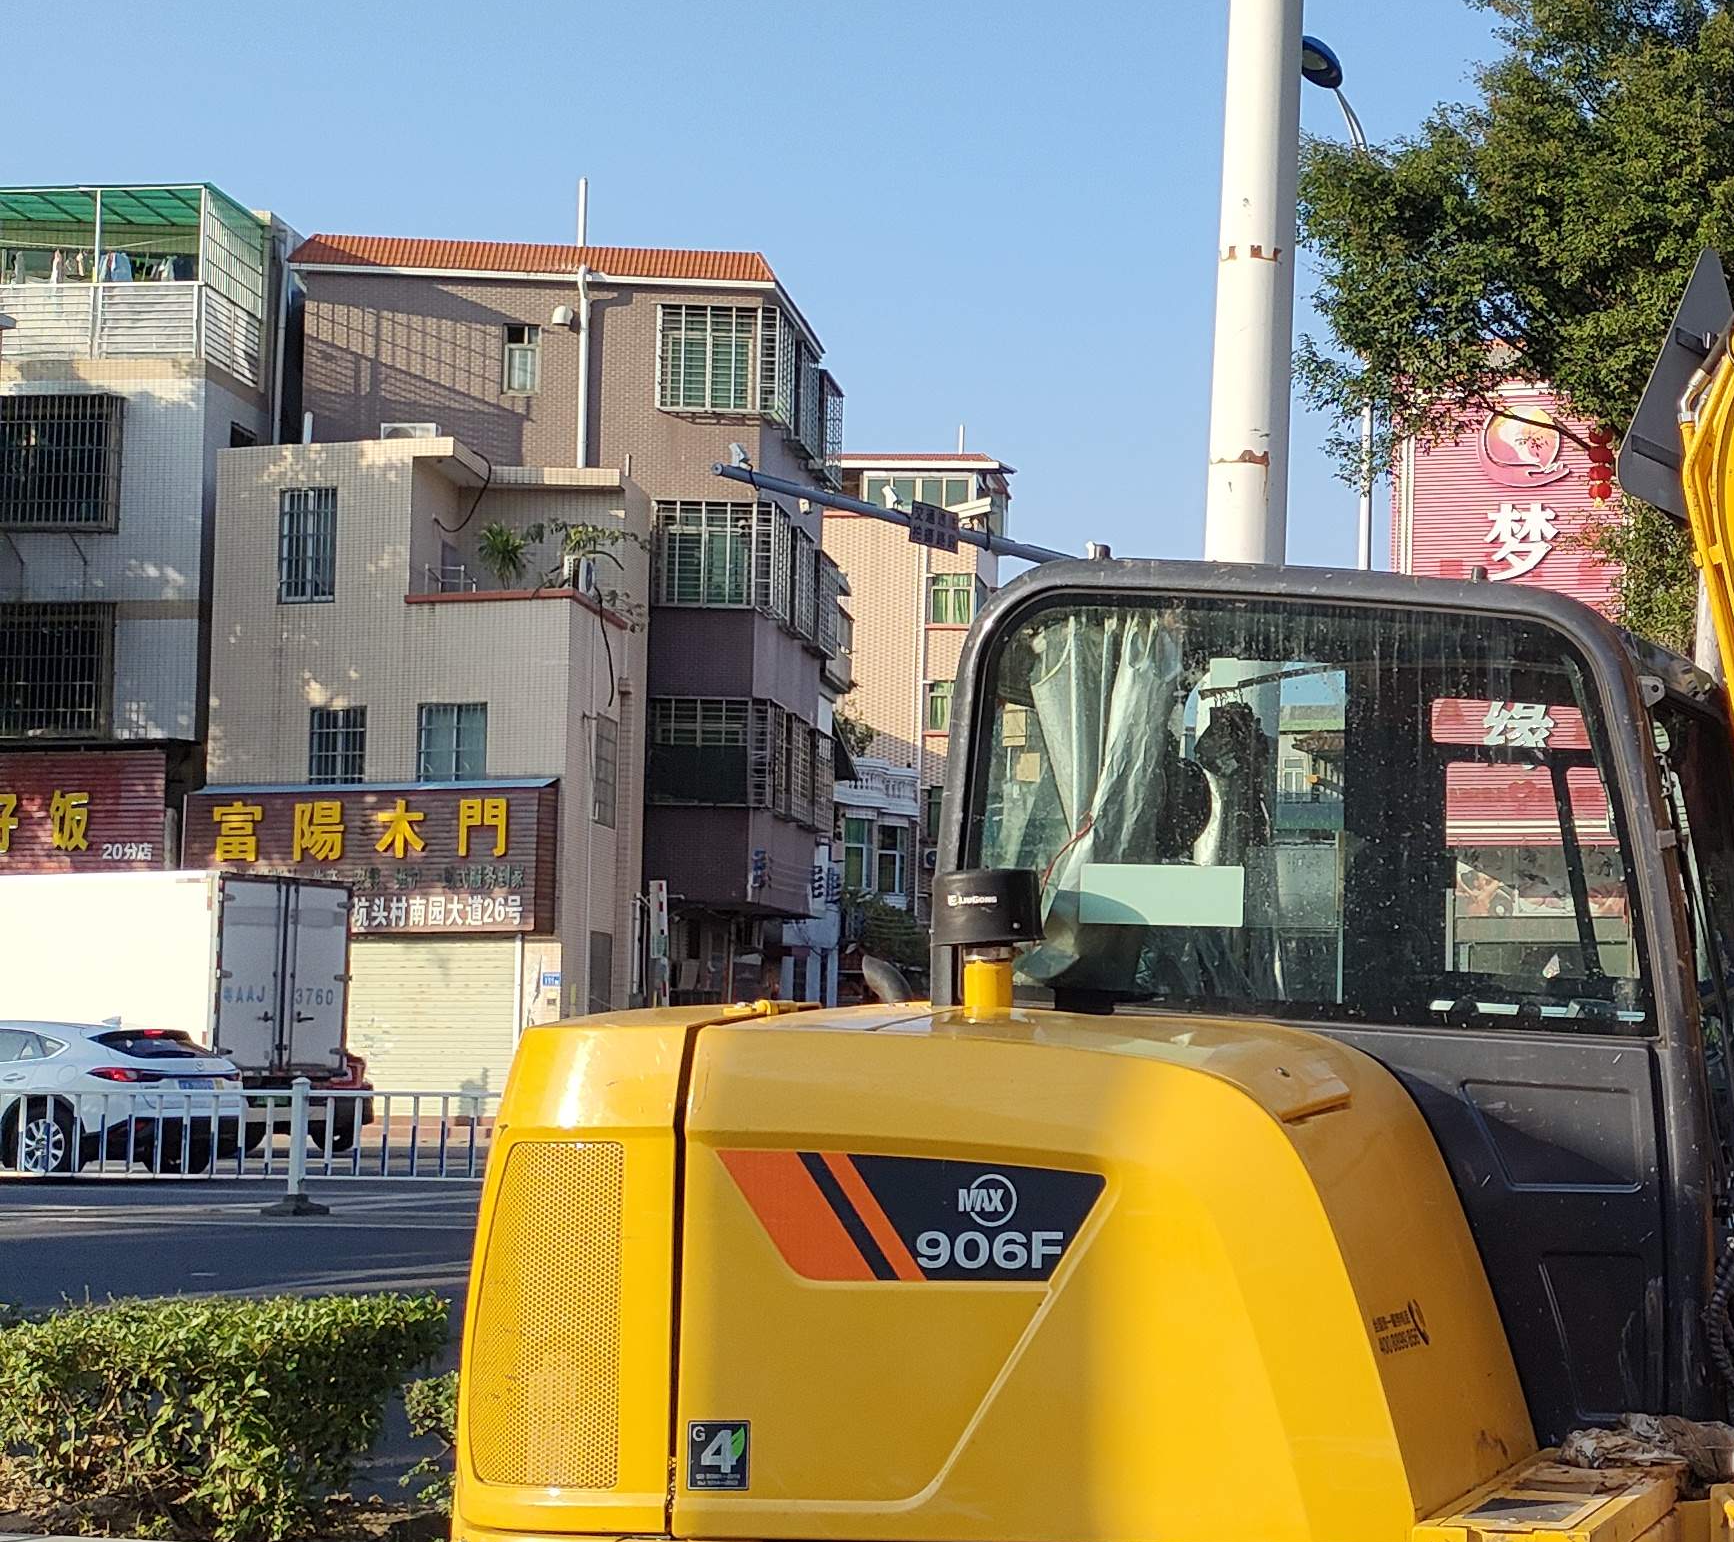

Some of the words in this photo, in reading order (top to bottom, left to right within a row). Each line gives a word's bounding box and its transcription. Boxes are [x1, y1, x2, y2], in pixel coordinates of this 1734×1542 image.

[212, 799, 509, 862] 富陽木門
[102, 843, 153, 861] 20分店
[295, 988, 334, 1006] 3760
[957, 1187, 1005, 1213] MAX
[915, 1230, 1064, 1270] 906F
[700, 1429, 737, 1474] 4
